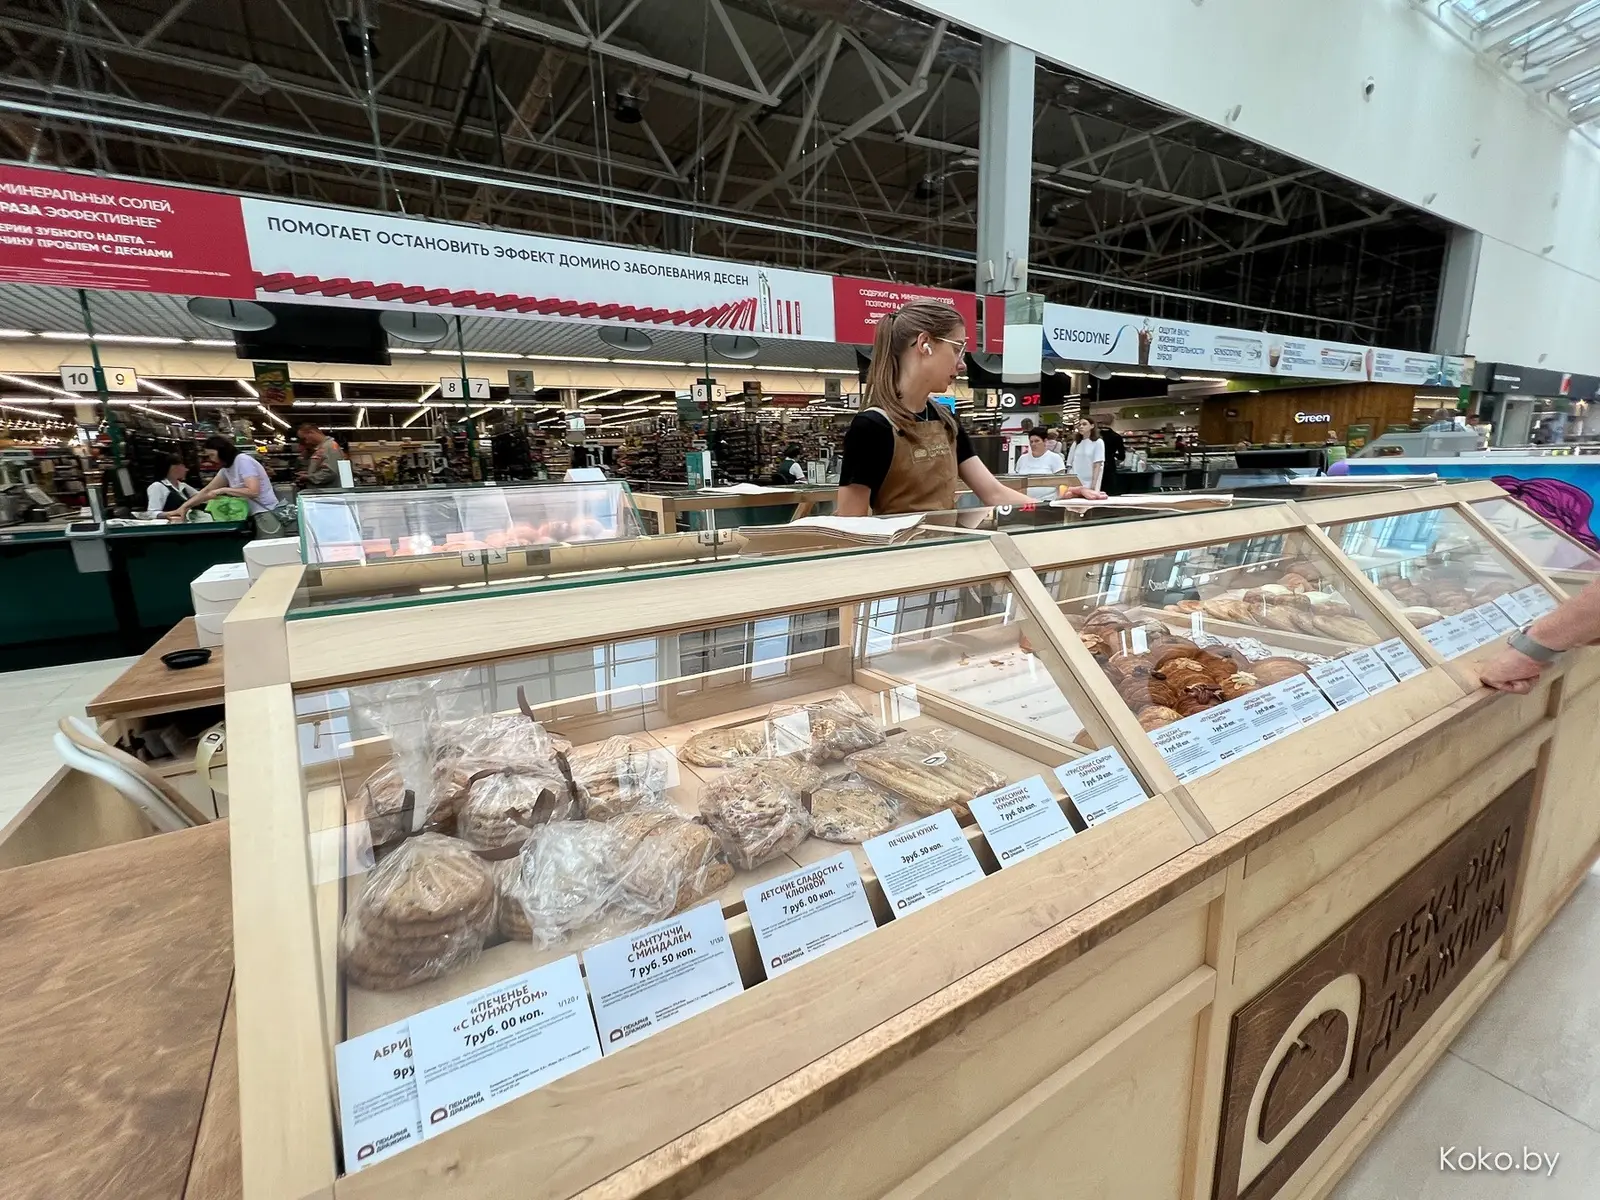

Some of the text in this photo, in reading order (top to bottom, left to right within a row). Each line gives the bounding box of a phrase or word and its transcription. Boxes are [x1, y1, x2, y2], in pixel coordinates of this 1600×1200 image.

[0, 202, 42, 216] РАЗА
[36, 227, 94, 240] ЗУБНОГО
[97, 233, 144, 245] НАЛЕТА
[38, 239, 99, 252] ПРОБЛЕМ
[102, 245, 112, 253] С
[115, 246, 173, 258] ДЕСНАМИ
[267, 216, 749, 286] ПОМОГАЕТ ОСТАНОВИТЬ ЭФФЕКТ ДОМИНО ЗАБОЛЕВАНИЯ ДЕСЕН
[1053, 327, 1110, 345] SENSODYNE
[69, 373, 88, 385] 10
[115, 373, 125, 385] 9
[448, 382, 456, 393] 8
[475, 383, 484, 393] 7
[697, 388, 703, 397] 6
[716, 389, 722, 397] 5
[1294, 411, 1330, 424] Green
[888, 823, 939, 848] ПЕЧЕНЬЕ КУКИС
[900, 842, 943, 864] 3руб. 50 коп.
[760, 862, 844, 903] ДЕТСКИЕ СЛАДОСТИ С
[785, 878, 826, 900] КЛЮКВОЙ
[782, 906, 788, 914] 7
[790, 900, 807, 914] руб.
[808, 895, 818, 904] 00
[819, 888, 836, 900] коп.
[1382, 825, 1511, 989] ПЕКАРНЯ
[627, 932, 692, 963] С МИНДАЛЕМ
[631, 925, 684, 951] КАНТУЧЧИ
[630, 947, 696, 978] 7 руб. 50 коп.
[1367, 879, 1506, 1073] ДРАЖИНА
[470, 985, 529, 1014] «ПЕЧЕНЬЕ
[558, 996, 575, 1008] 1/120
[453, 1019, 469, 1032] «С
[471, 990, 548, 1025] КУНЖУТОМ»
[464, 1025, 498, 1047] 7руб.
[501, 1017, 516, 1031] 00
[519, 1008, 544, 1024] коп.
